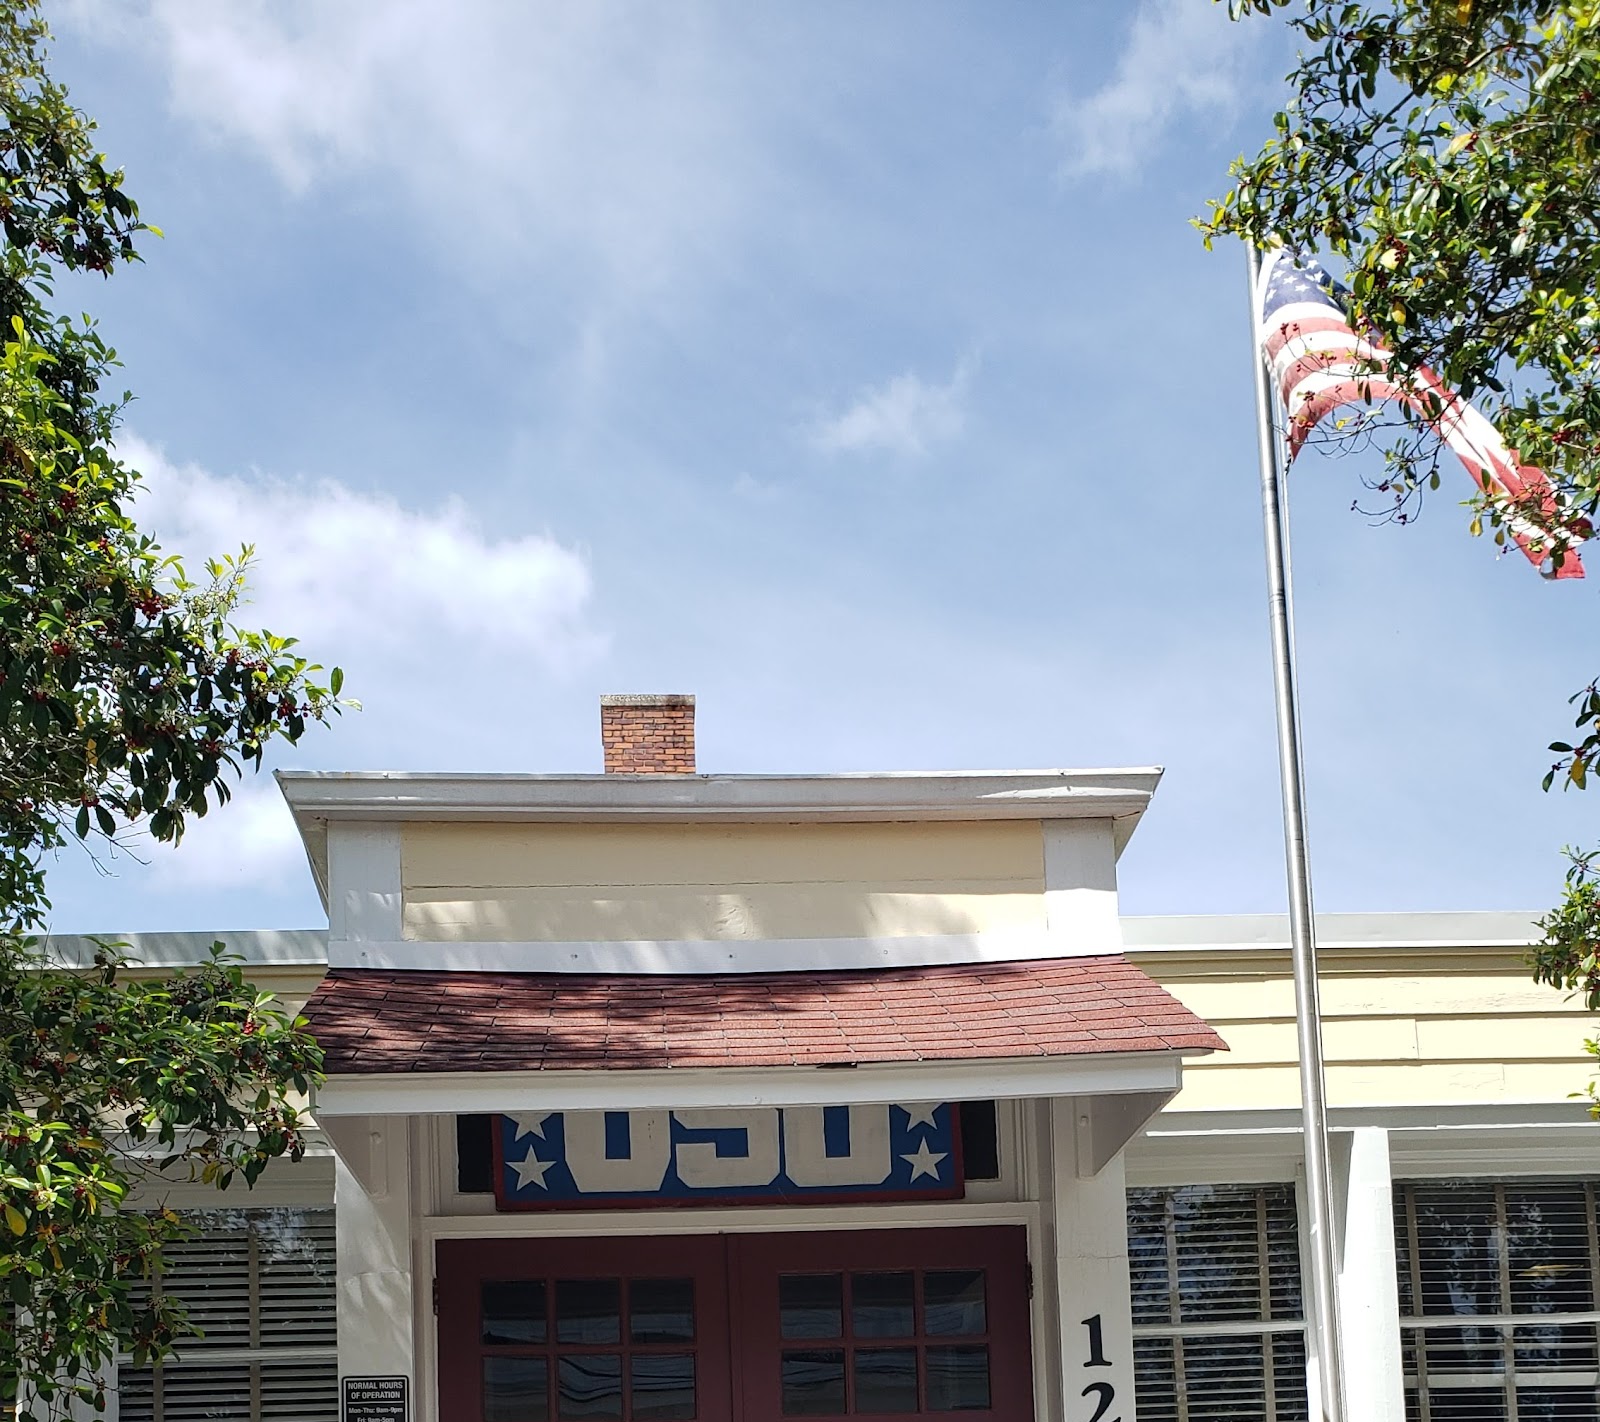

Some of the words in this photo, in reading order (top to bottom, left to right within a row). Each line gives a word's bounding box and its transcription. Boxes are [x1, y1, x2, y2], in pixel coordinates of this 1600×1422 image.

[348, 1382, 378, 1390] NORMAL
[379, 1381, 403, 1389] HOURS
[362, 1391, 401, 1399] OPERATION
